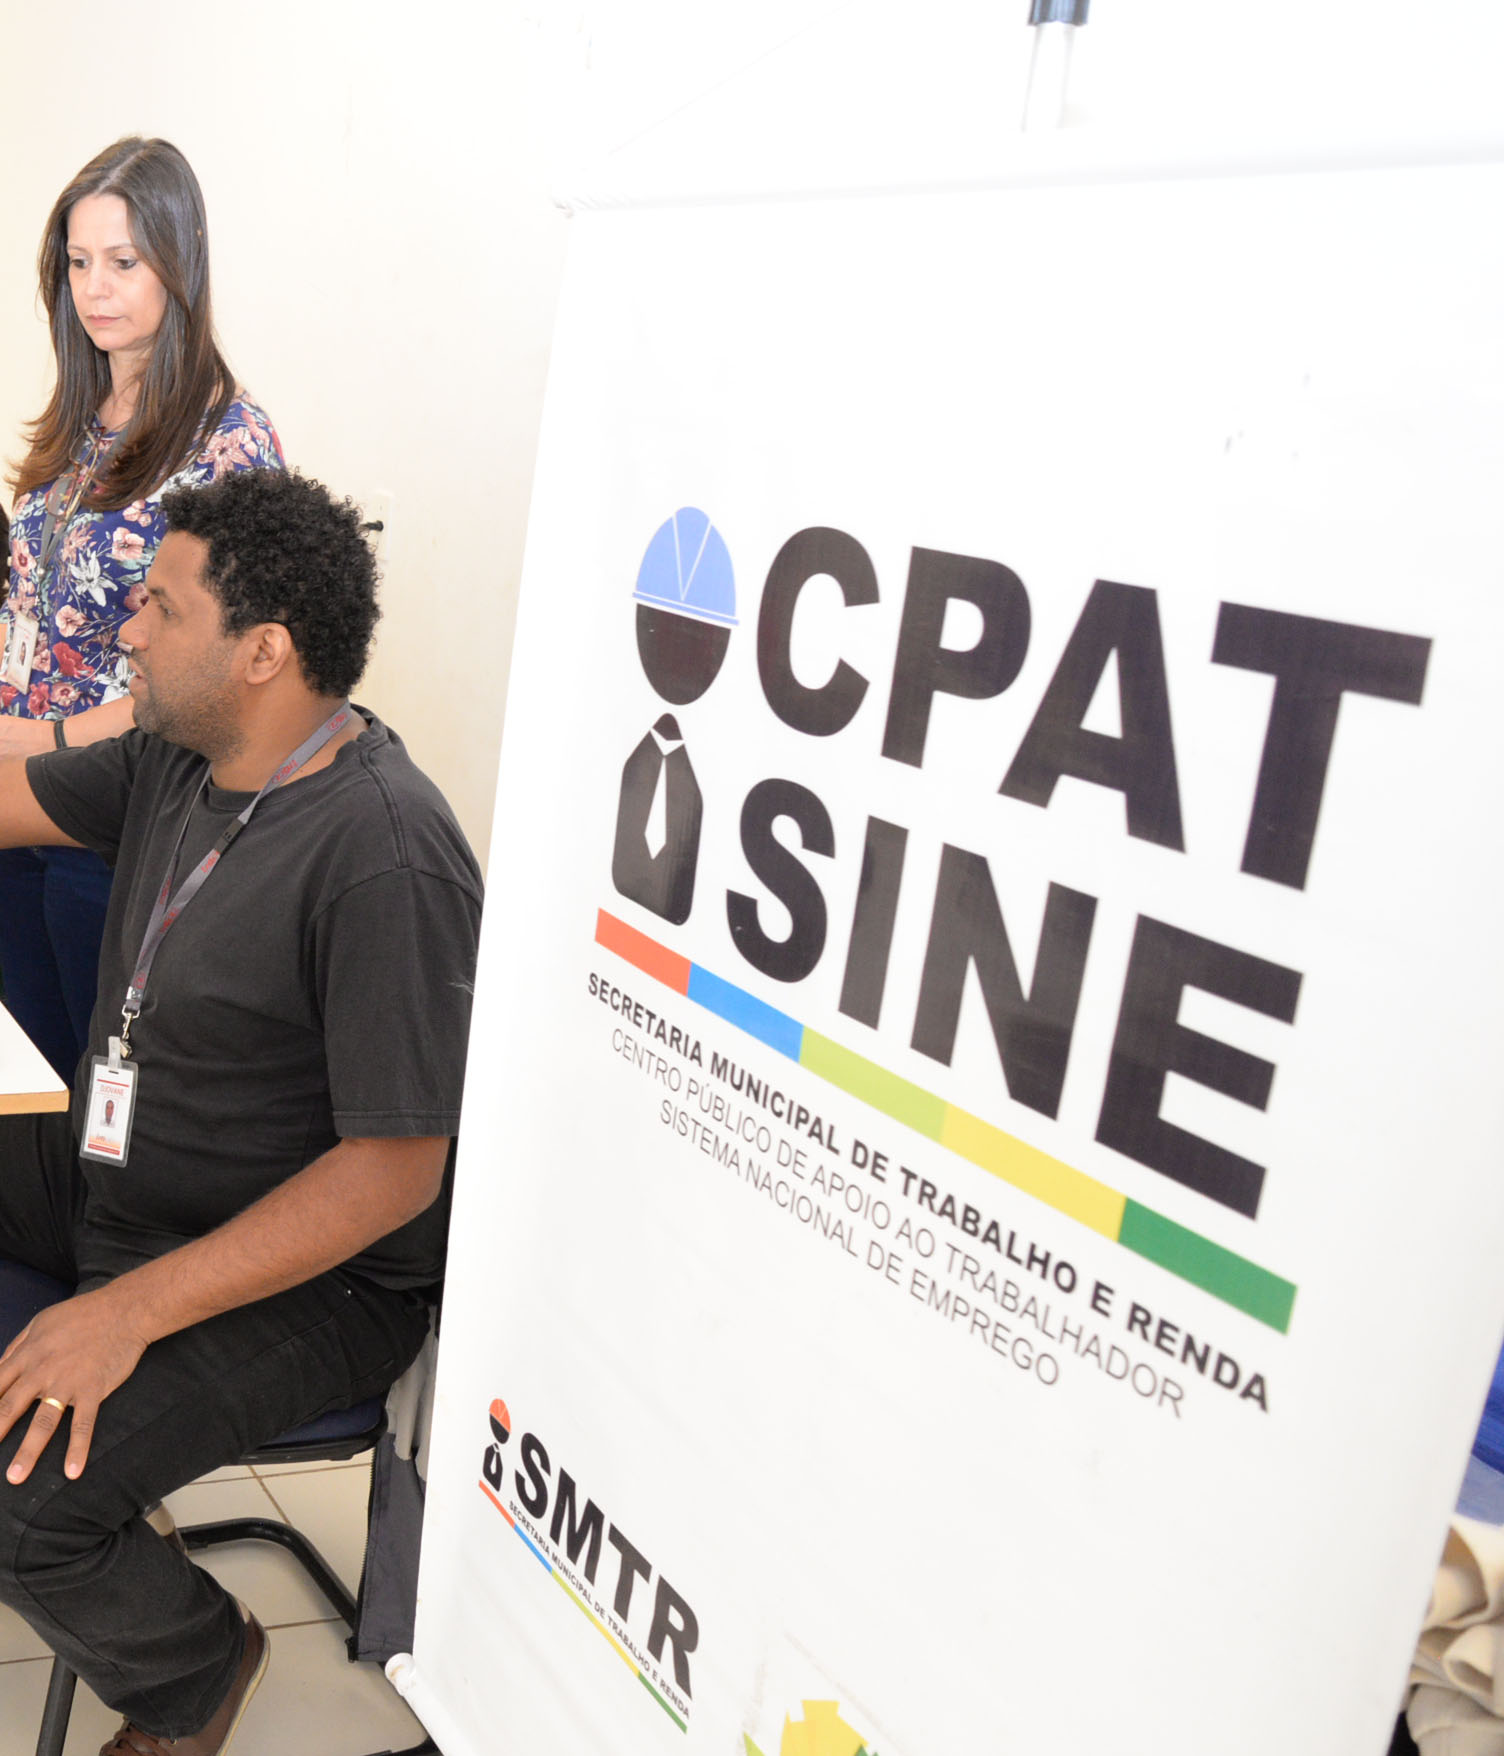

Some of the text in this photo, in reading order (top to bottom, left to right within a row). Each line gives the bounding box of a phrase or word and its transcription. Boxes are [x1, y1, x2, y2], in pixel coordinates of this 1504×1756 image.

[756, 526, 1433, 892] CPAT
[726, 777, 1305, 1222] SINE
[588, 972, 1269, 1414] SECRETARIA MUNICIPAL DE TRABALHO E RENDA
[611, 1027, 1184, 1419] CENTRO PÚBLICO DE APOIO AO TRABALHADOR
[659, 1099, 1060, 1387] SISTEMA NACIONAL DE EMPREGO
[508, 1499, 690, 1720] SECRETARIA MUNICIPAL DE TRABALHO E RENDA
[514, 1431, 700, 1702] SMTR
